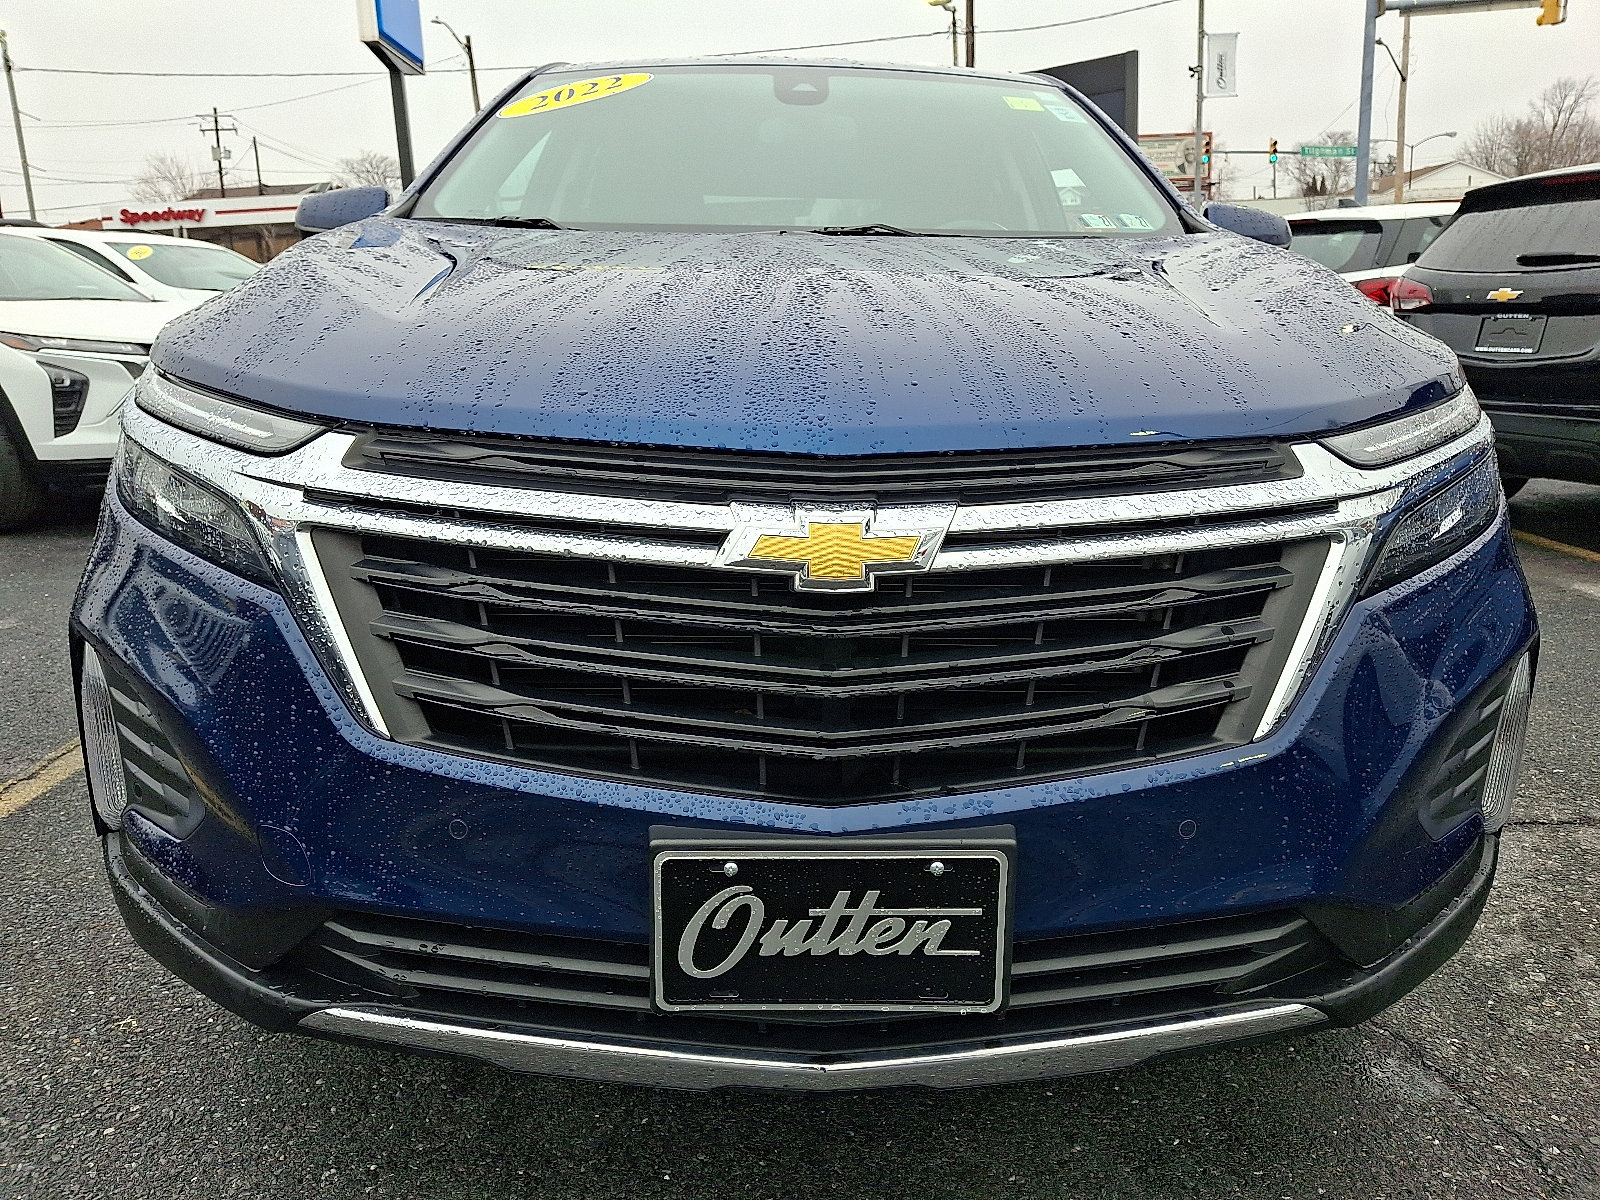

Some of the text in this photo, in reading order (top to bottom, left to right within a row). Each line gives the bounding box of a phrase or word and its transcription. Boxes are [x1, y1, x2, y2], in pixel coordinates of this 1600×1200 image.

[529, 77, 622, 110] 2022
[1346, 147, 1356, 156] St
[120, 207, 205, 226] Speedway
[678, 885, 983, 979] Outten
